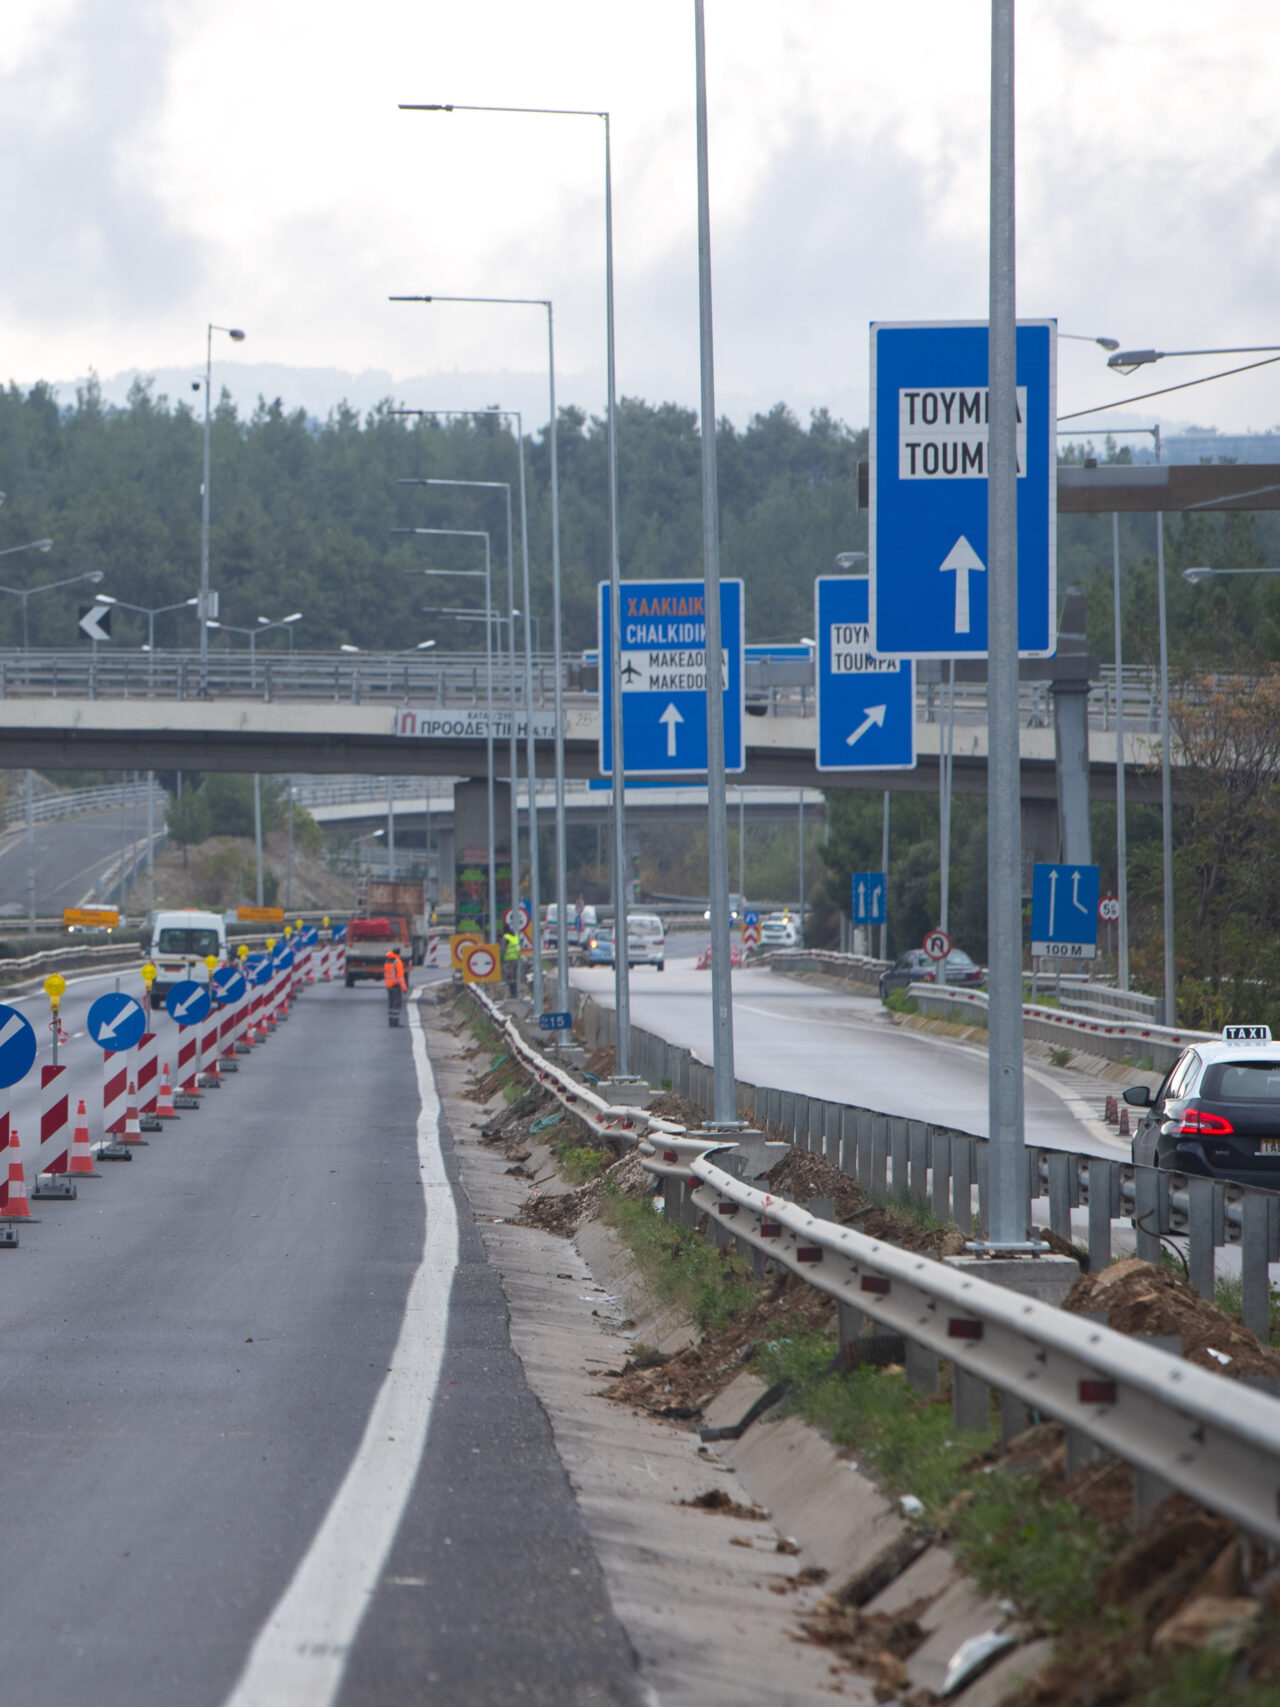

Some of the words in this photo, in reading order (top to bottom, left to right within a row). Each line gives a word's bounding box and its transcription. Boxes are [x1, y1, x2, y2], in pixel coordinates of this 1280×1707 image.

[904, 392, 1022, 425] ΤΟΥΜ
[905, 442, 1021, 475] TOUM
[628, 597, 705, 616] ΧΑΛΚΙΔΙΚ
[626, 623, 706, 644] CHALKIDI
[649, 651, 726, 667] ΜΑΚΕΔΟ
[649, 674, 725, 689] MAKEDO
[421, 721, 528, 736] ΠΡΟΟΔΕΤΙΗ
[1046, 944, 1068, 954] 100
[1071, 945, 1082, 956] M
[550, 1016, 564, 1028] 15
[1229, 1028, 1265, 1039] TAXI
